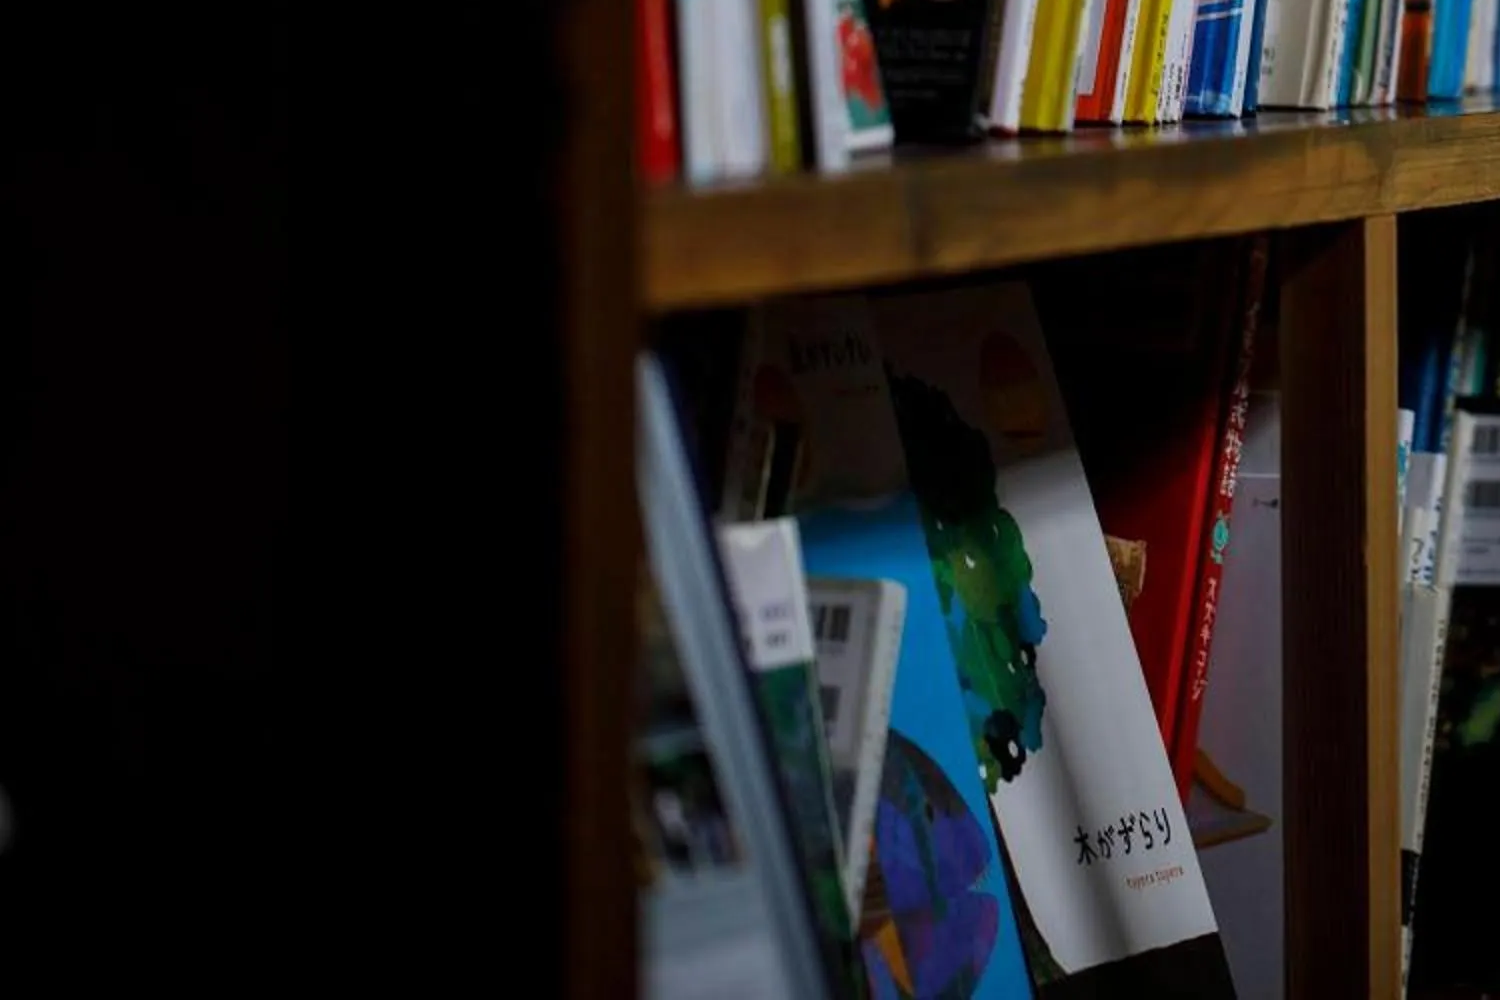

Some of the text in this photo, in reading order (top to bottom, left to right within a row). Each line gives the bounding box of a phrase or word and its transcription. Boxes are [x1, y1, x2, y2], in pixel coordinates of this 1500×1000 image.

[1074, 807, 1172, 865] 木がずらり
